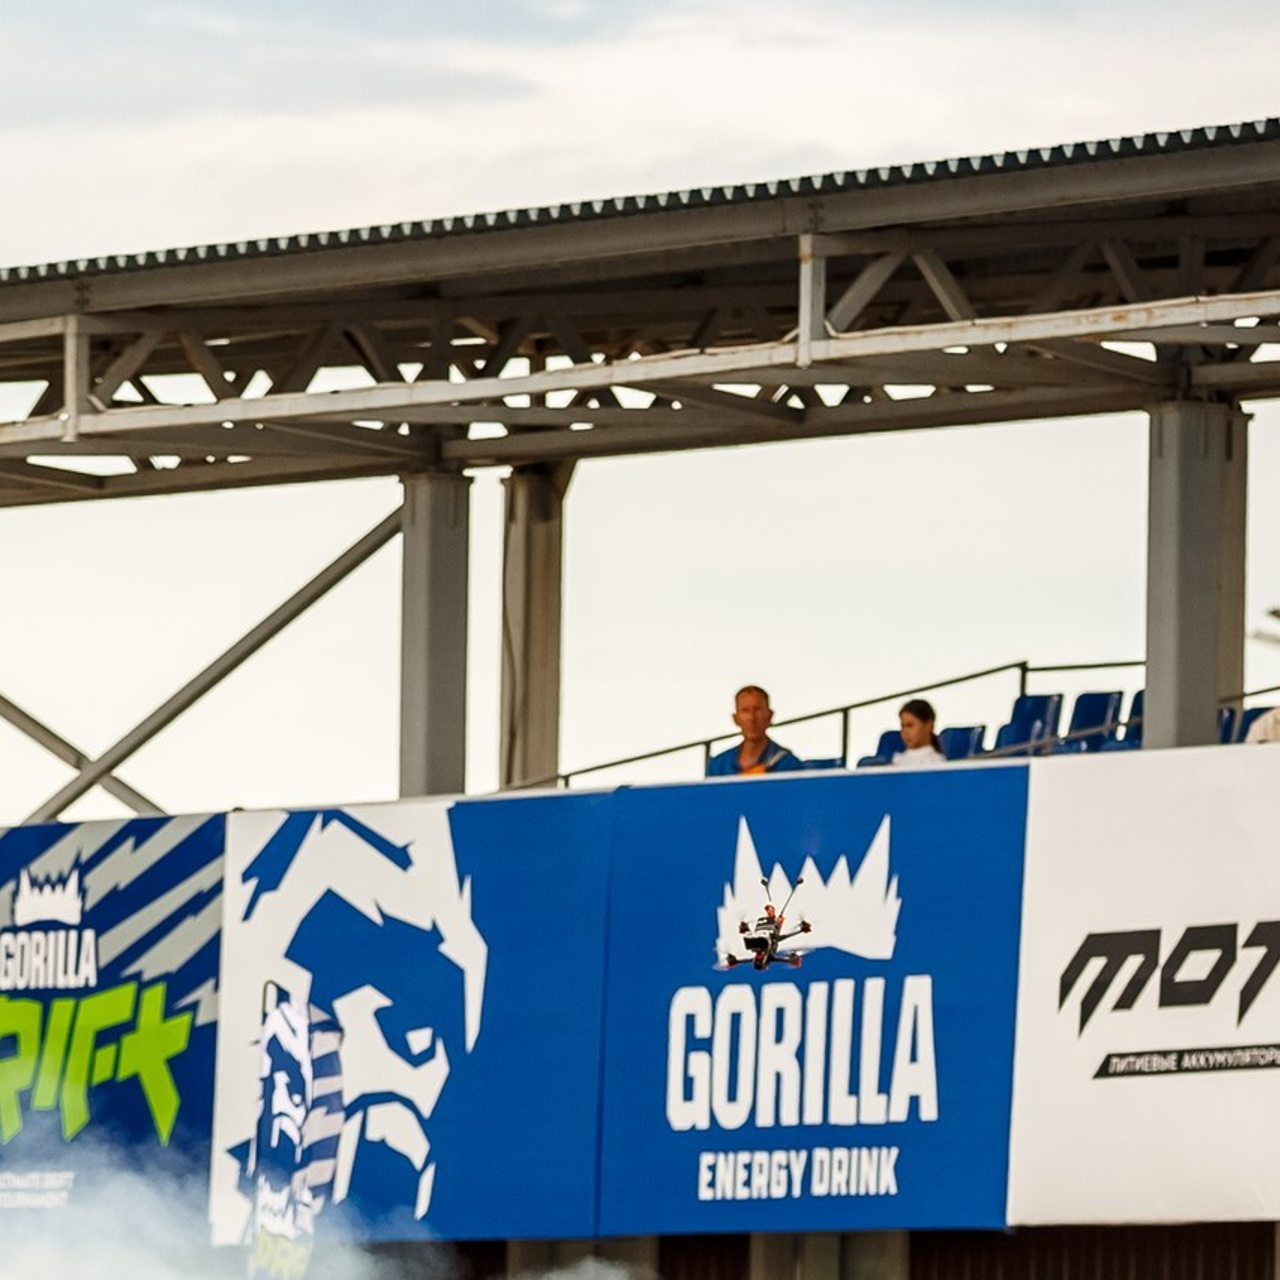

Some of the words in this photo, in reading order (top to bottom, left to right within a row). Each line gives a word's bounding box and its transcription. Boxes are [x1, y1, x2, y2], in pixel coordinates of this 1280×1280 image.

[665, 974, 939, 1131] GORILLA
[698, 1150, 807, 1200] ENERGY
[811, 1147, 899, 1196] DRINK
